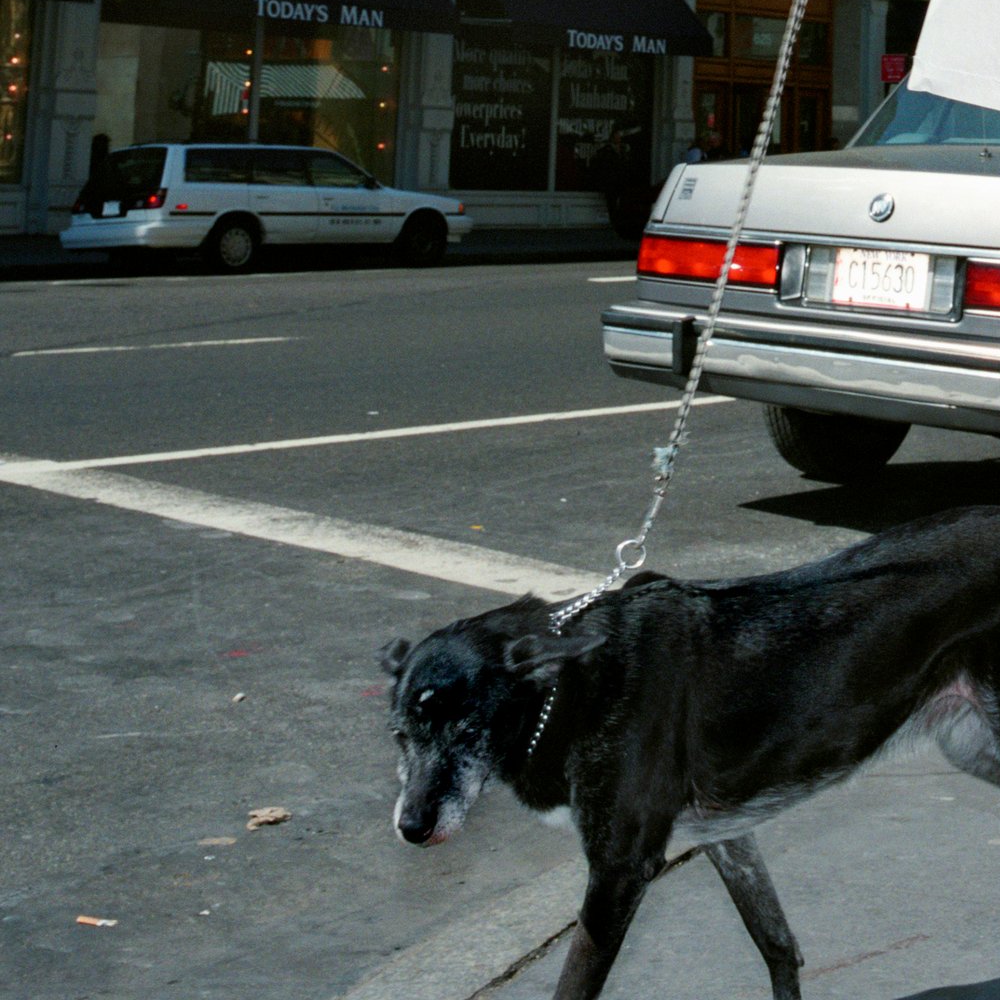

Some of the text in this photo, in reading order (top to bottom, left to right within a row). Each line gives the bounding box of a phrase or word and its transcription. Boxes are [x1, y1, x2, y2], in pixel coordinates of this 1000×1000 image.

[340, 5, 385, 27] MAN
[567, 29, 667, 54] TODAY'S MAN
[460, 124, 527, 157] Everyday!
[848, 260, 915, 294] C15630
